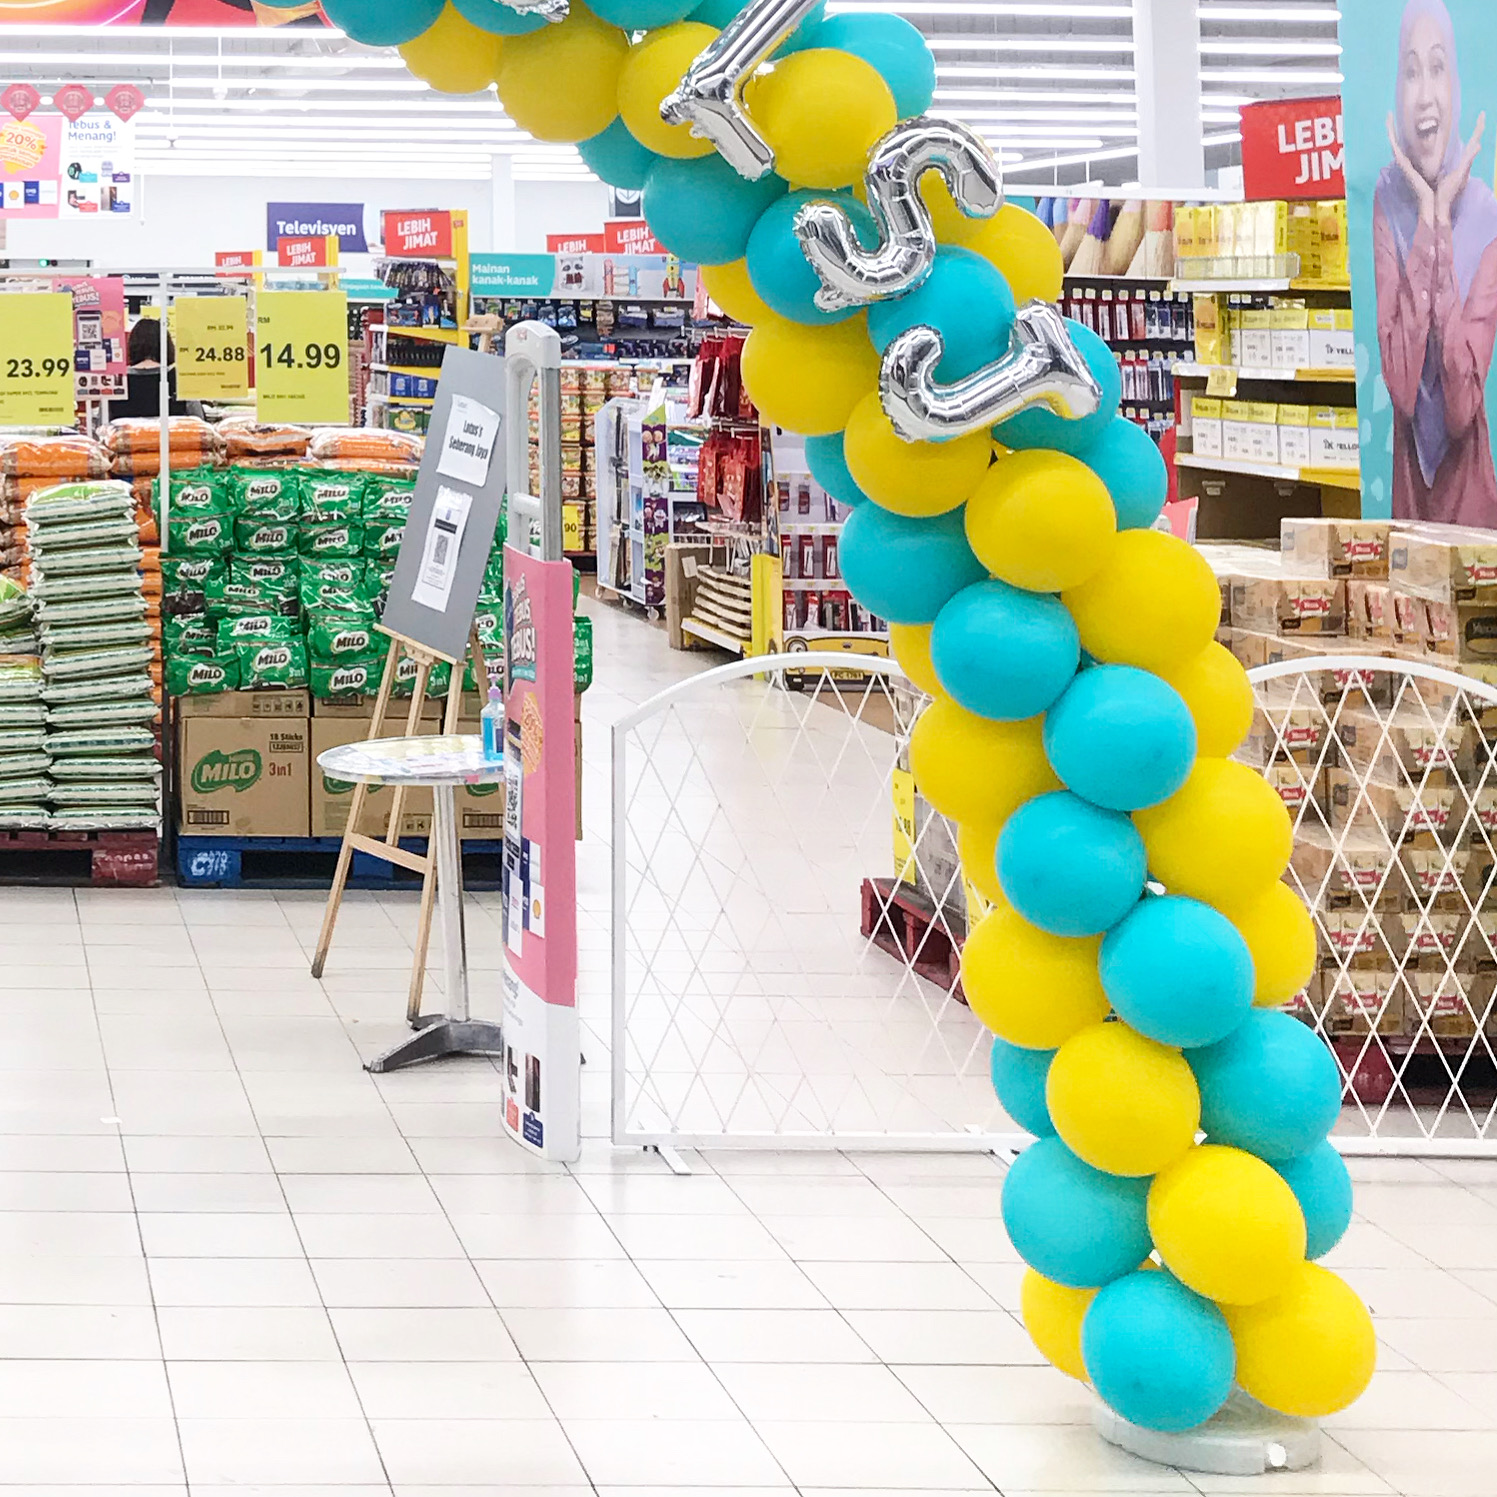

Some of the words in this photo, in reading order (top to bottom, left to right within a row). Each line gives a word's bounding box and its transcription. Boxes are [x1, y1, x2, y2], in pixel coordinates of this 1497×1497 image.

[7, 132, 37, 151] 20%
[68, 130, 117, 144] Menang!
[1277, 115, 1343, 154] LEBI
[277, 220, 356, 237] Televisyen
[397, 218, 431, 237] LEBIH
[403, 232, 438, 250] JIMAT
[617, 226, 649, 245] LEBIH
[286, 242, 312, 256] LEBIH
[558, 239, 587, 254] LEBIH
[624, 238, 655, 254] JIMAT
[290, 251, 316, 266] JIMAT
[472, 264, 510, 274] Mainan
[472, 275, 538, 286] kanak-kanak
[195, 347, 245, 362] 24.88
[260, 342, 340, 369] 14.99
[6, 358, 70, 378] 23.99
[189, 525, 217, 541] MILO
[255, 531, 284, 545] MILO
[336, 636, 365, 649] MILO
[257, 652, 287, 666] MILO
[191, 669, 222, 681] MILO
[333, 673, 364, 687] MILO
[202, 762, 256, 785] MILO
[269, 761, 292, 776] 3in1
